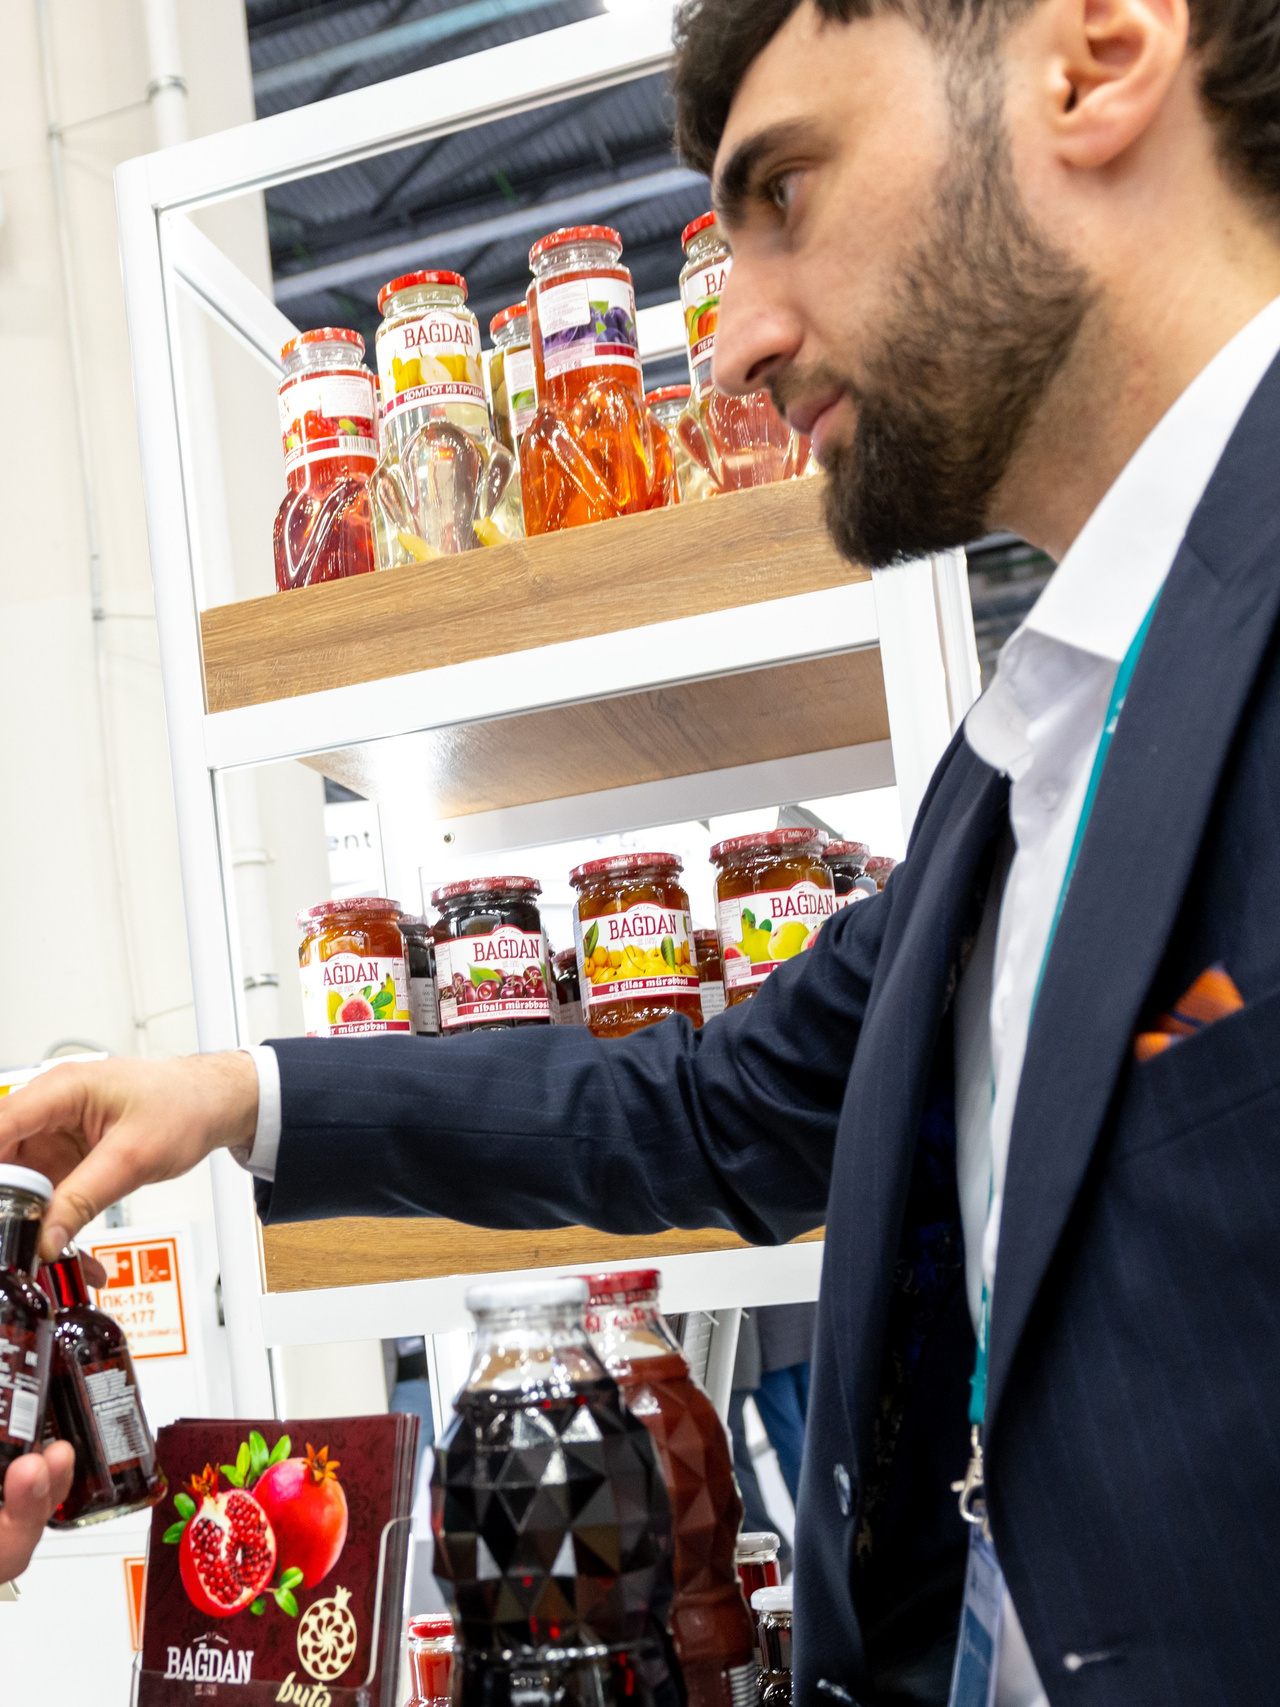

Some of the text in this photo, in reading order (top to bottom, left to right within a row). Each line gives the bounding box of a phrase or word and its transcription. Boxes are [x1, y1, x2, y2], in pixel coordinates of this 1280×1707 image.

[403, 320, 474, 349] BAĞDAN
[403, 384, 484, 402] КОМПОТ ИЗ ГРУШИ
[770, 891, 834, 918] BAĞDAN
[608, 913, 677, 941] BAĞDAN
[473, 936, 541, 962] BAĞDAN
[323, 961, 379, 986] AĞDAN
[110, 1309, 156, 1325] К-177
[163, 1642, 255, 1685] BAĞDAN
